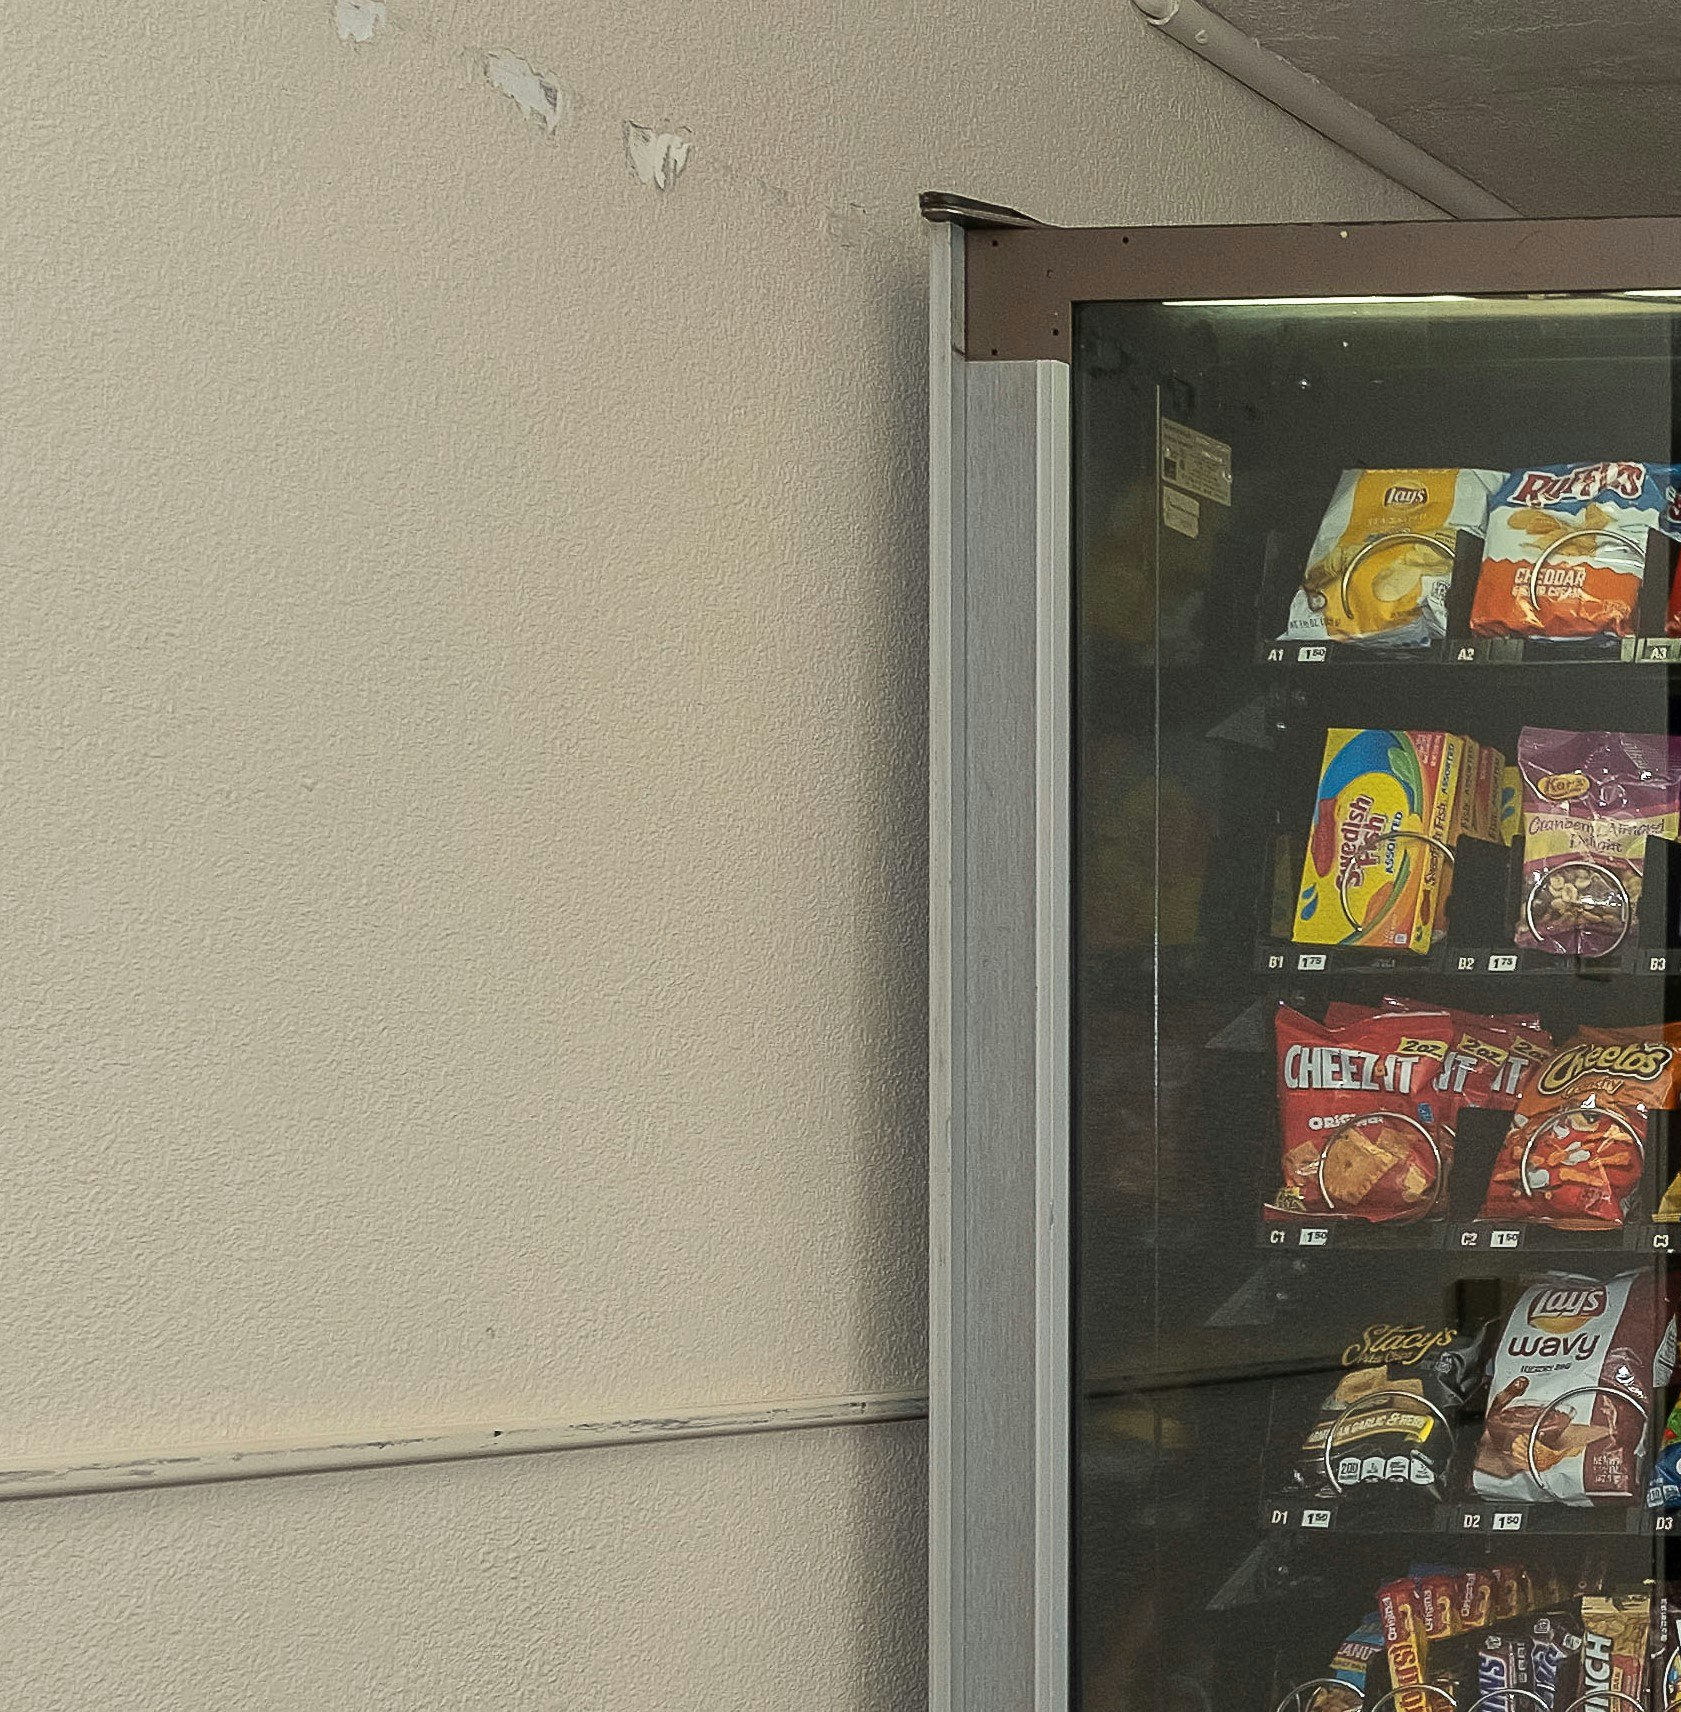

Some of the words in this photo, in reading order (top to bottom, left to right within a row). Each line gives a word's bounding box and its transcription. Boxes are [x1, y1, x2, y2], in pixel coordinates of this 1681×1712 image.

[1335, 793, 1375, 891] Swedish
[1540, 1045, 1670, 1096] Cheetos
[1508, 1333, 1600, 1361] wavy
